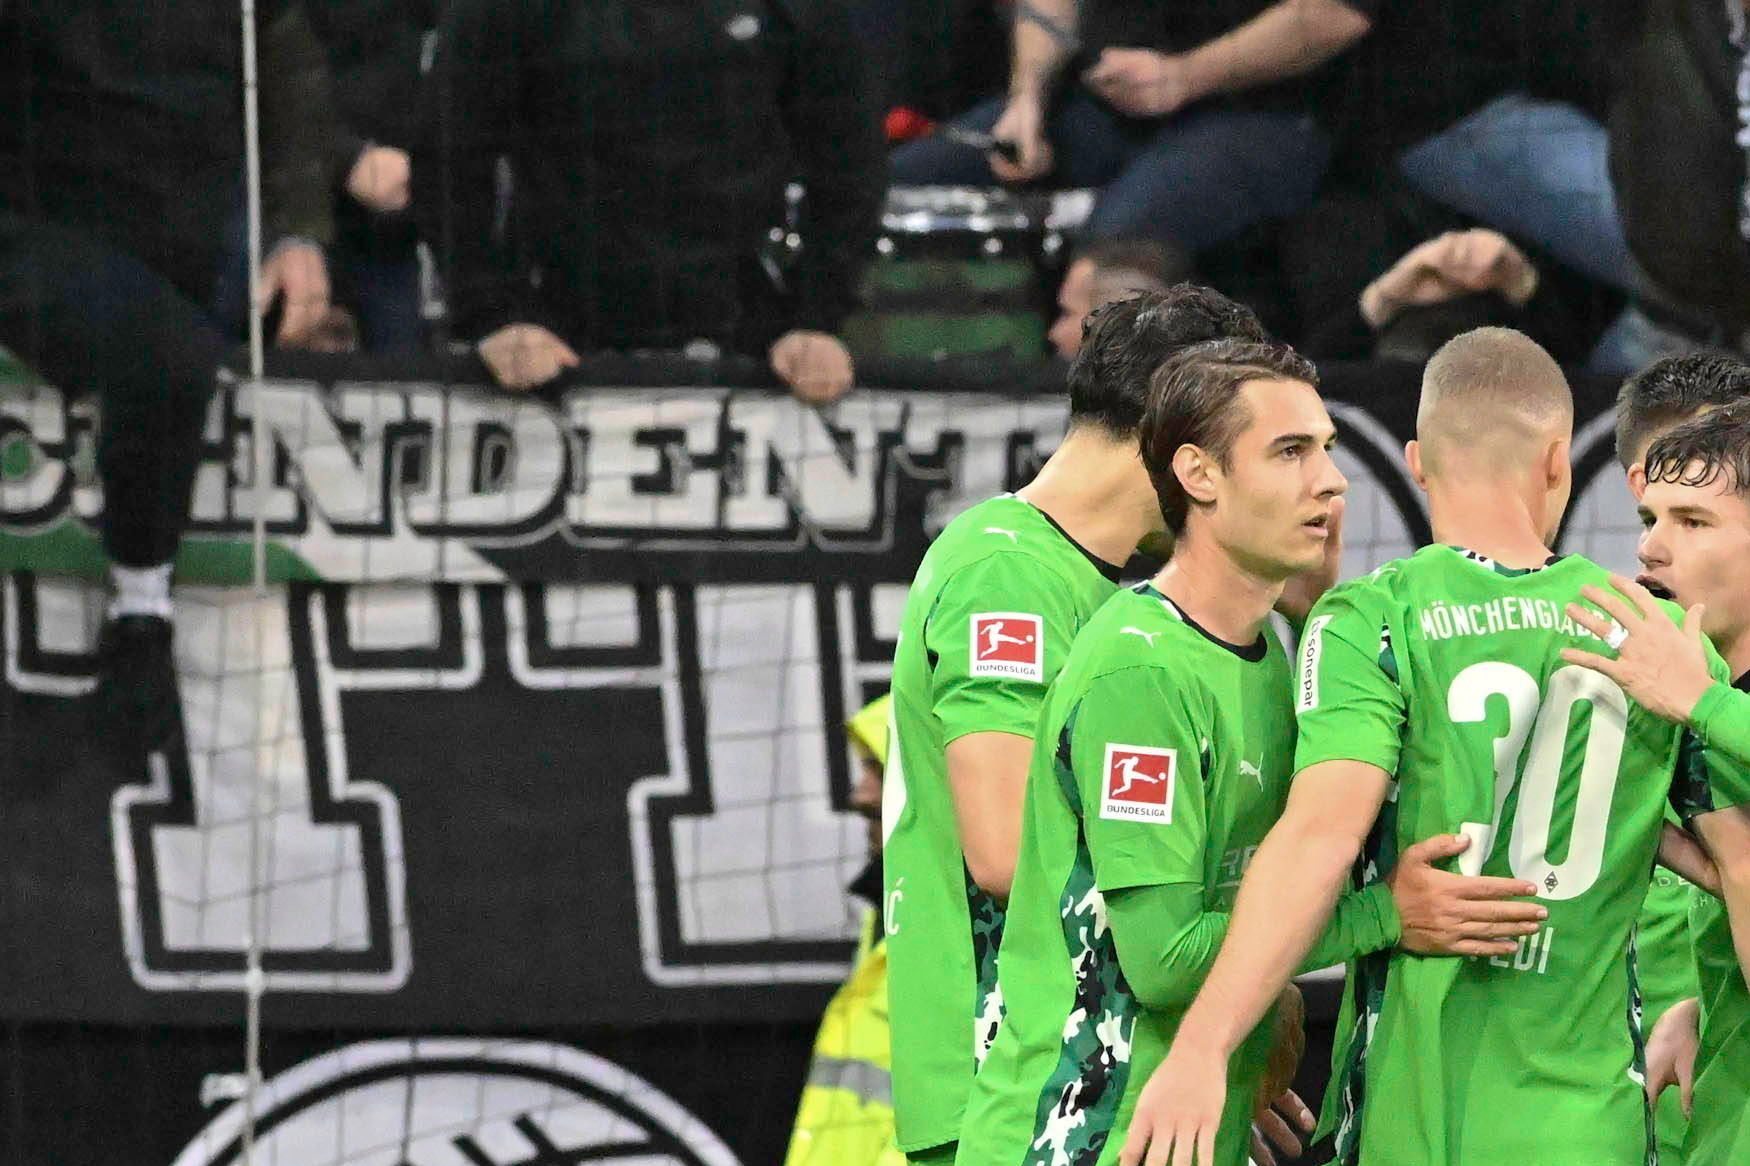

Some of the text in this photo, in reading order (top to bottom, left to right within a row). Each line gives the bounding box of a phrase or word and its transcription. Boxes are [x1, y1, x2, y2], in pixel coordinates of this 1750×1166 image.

[976, 664, 1036, 676] BUNDESLIGA
[1447, 660, 1629, 901] 30
[1106, 804, 1166, 818] BUNDESLIGA
